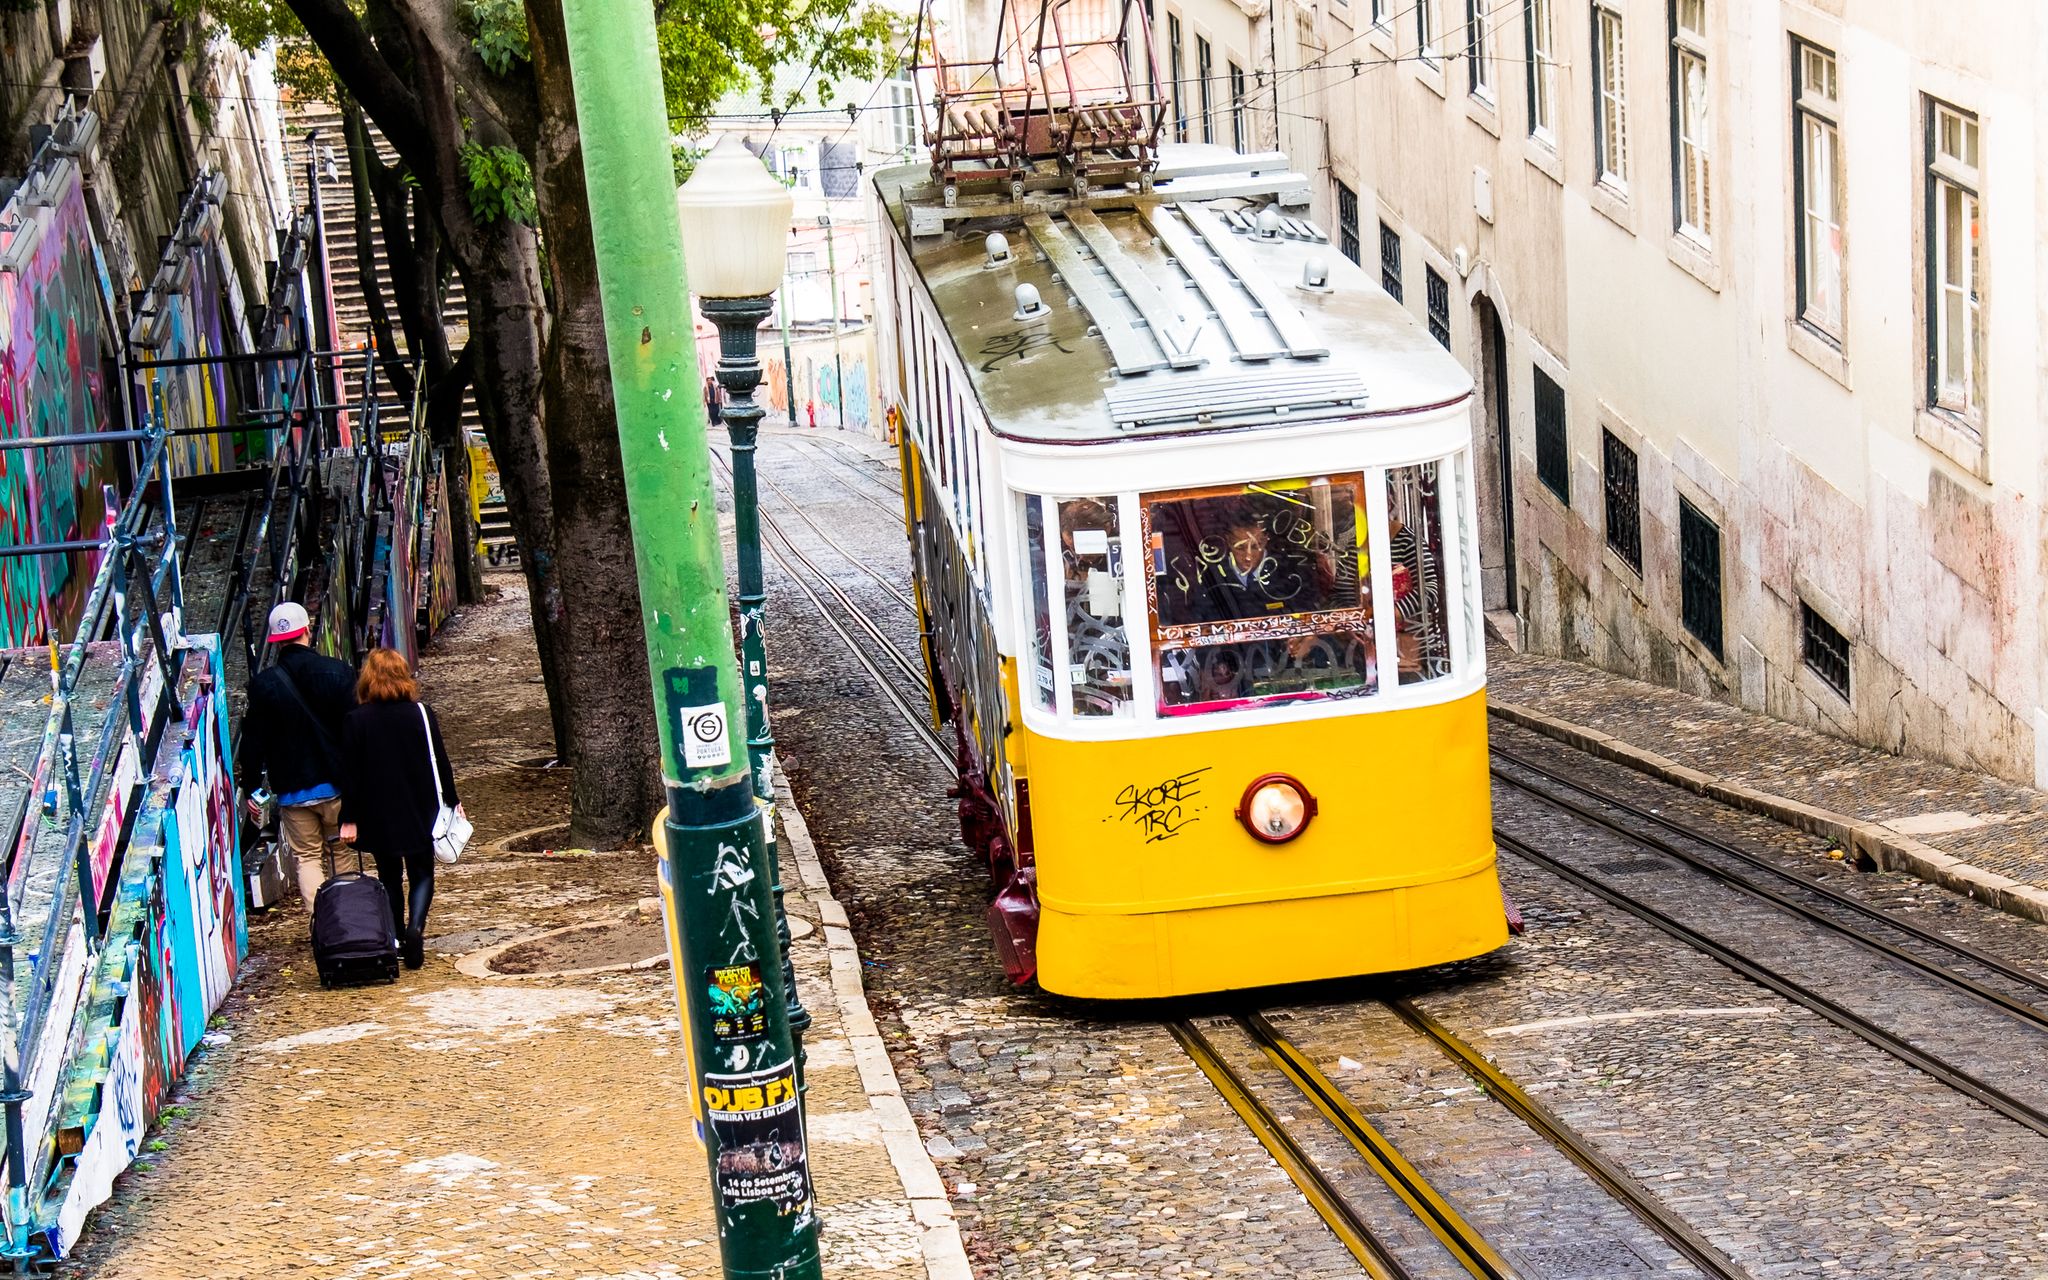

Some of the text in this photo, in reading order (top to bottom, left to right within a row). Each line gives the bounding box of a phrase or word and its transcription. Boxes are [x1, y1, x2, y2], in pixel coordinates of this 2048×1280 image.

[714, 966, 750, 978] INFECTED
[719, 974, 739, 985] FEST
[703, 1086, 764, 1111] DUB
[766, 1074, 796, 1106] FX
[744, 1111, 762, 1121] VEZ
[763, 1109, 776, 1119] EM
[776, 1100, 797, 1115] LISBOA
[728, 1178, 739, 1188] 14
[740, 1179, 752, 1188] de
[754, 1171, 796, 1187] Setembro
[722, 1186, 740, 1197] Sala
[741, 1185, 774, 1197] Lisboa
[774, 1184, 786, 1193] ao
